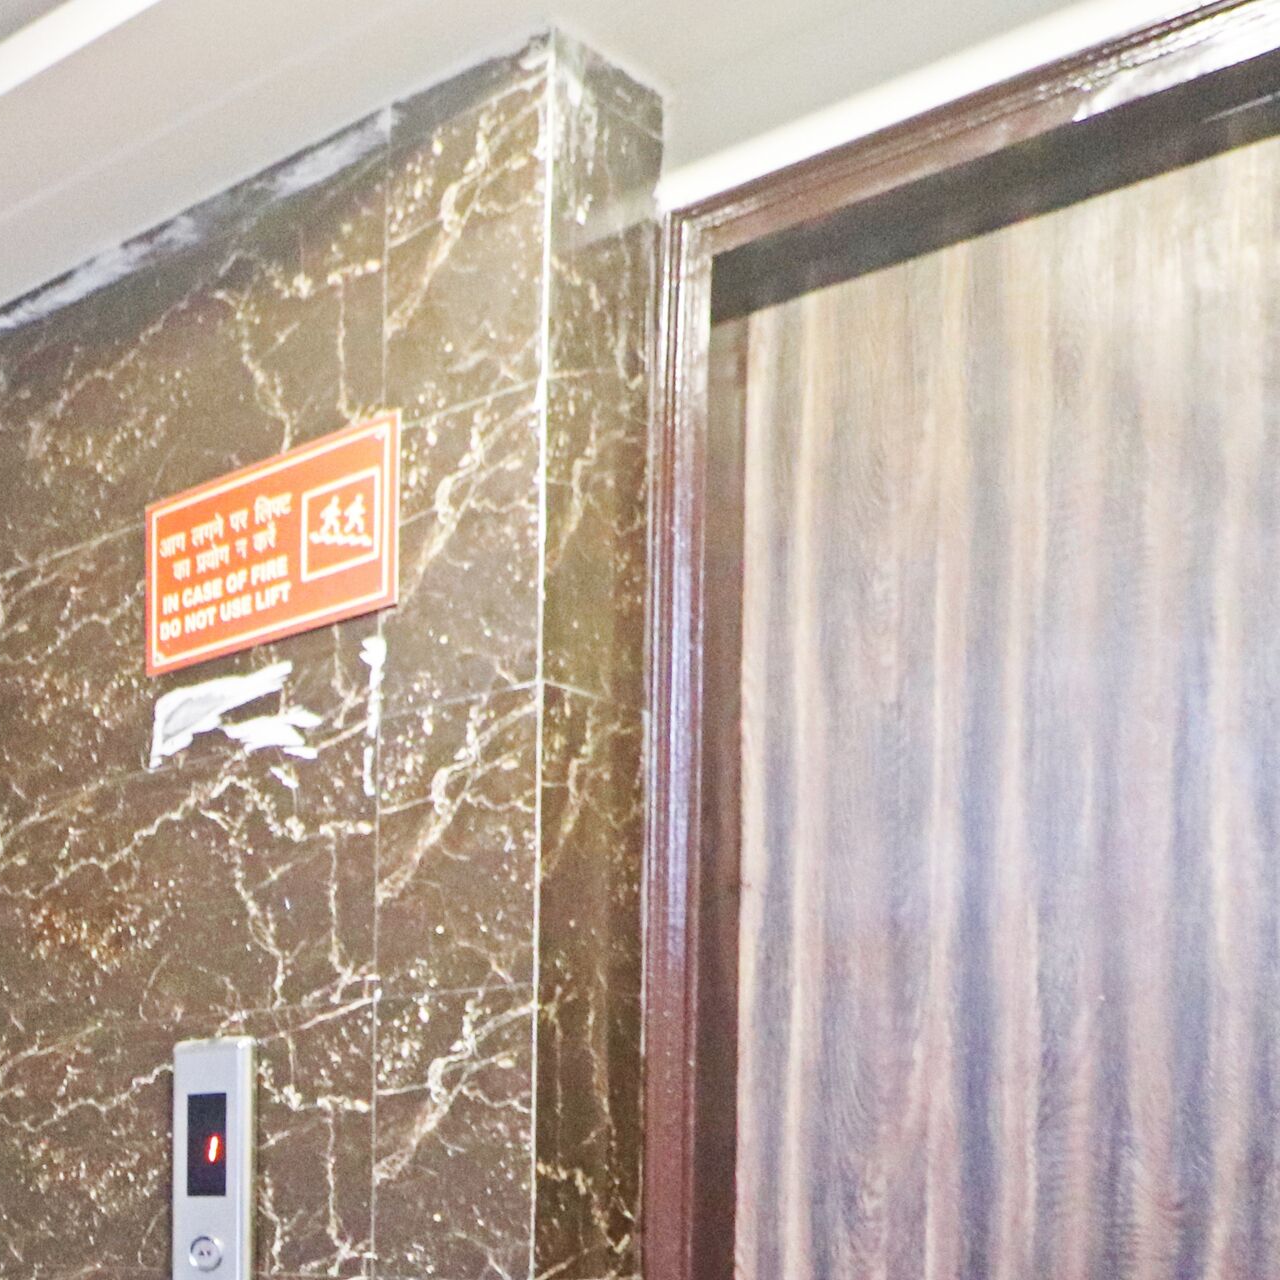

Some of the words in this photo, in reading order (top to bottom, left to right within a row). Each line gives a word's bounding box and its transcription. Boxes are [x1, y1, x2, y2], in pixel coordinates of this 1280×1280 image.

[159, 620, 181, 641] DO
[184, 606, 217, 634] NOT
[220, 593, 252, 622] USE
[255, 581, 292, 611] LIFT
[162, 592, 179, 615] IN
[182, 578, 223, 608] CASE
[226, 570, 248, 593] OF
[251, 555, 289, 586] FIRE
